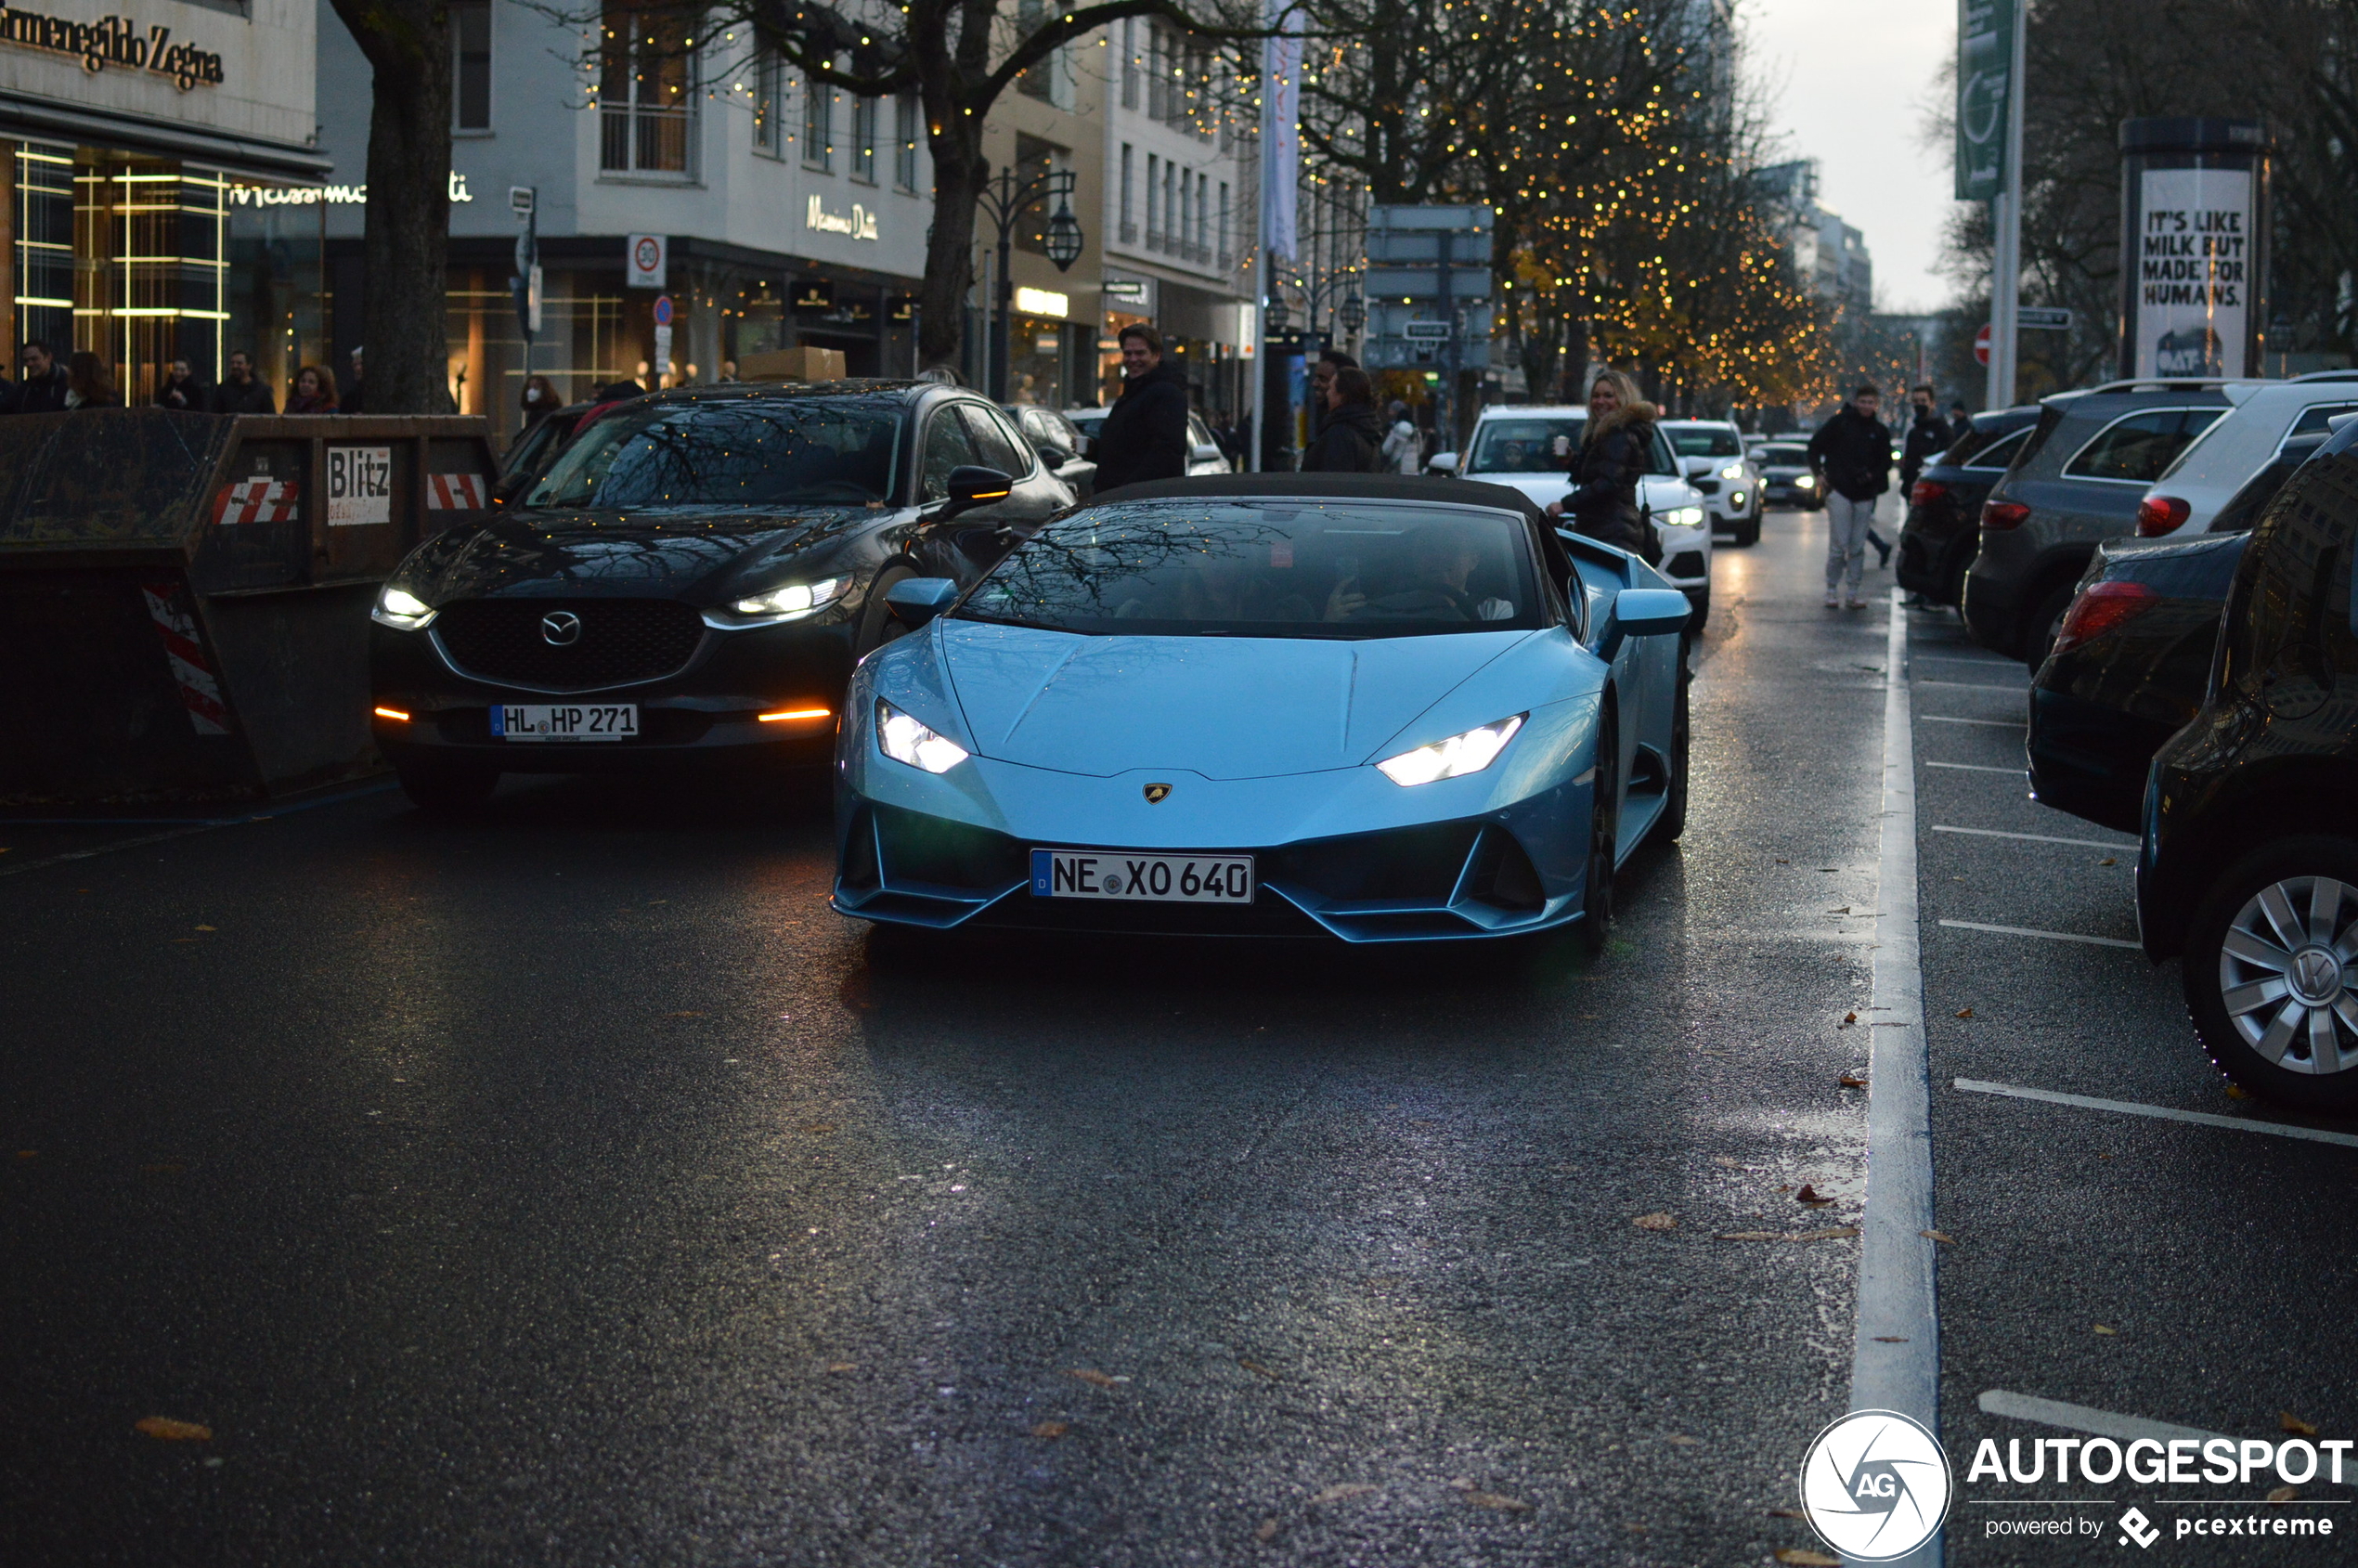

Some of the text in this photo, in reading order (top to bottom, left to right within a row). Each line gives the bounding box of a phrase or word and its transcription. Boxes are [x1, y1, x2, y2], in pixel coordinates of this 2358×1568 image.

[149, 25, 224, 91] Zegna
[2147, 211, 2242, 232] IT'S LIKE
[2144, 236, 2244, 257] MILK BUT
[2143, 260, 2243, 282] MADE FOR
[2144, 284, 2241, 307] HUMANS.
[330, 450, 389, 499] Blitz
[504, 707, 536, 732] HL
[551, 707, 583, 732] HP
[589, 706, 635, 732] 271
[1054, 857, 1100, 893] NE
[1125, 860, 1172, 896] XO
[1180, 862, 1248, 898] 640
